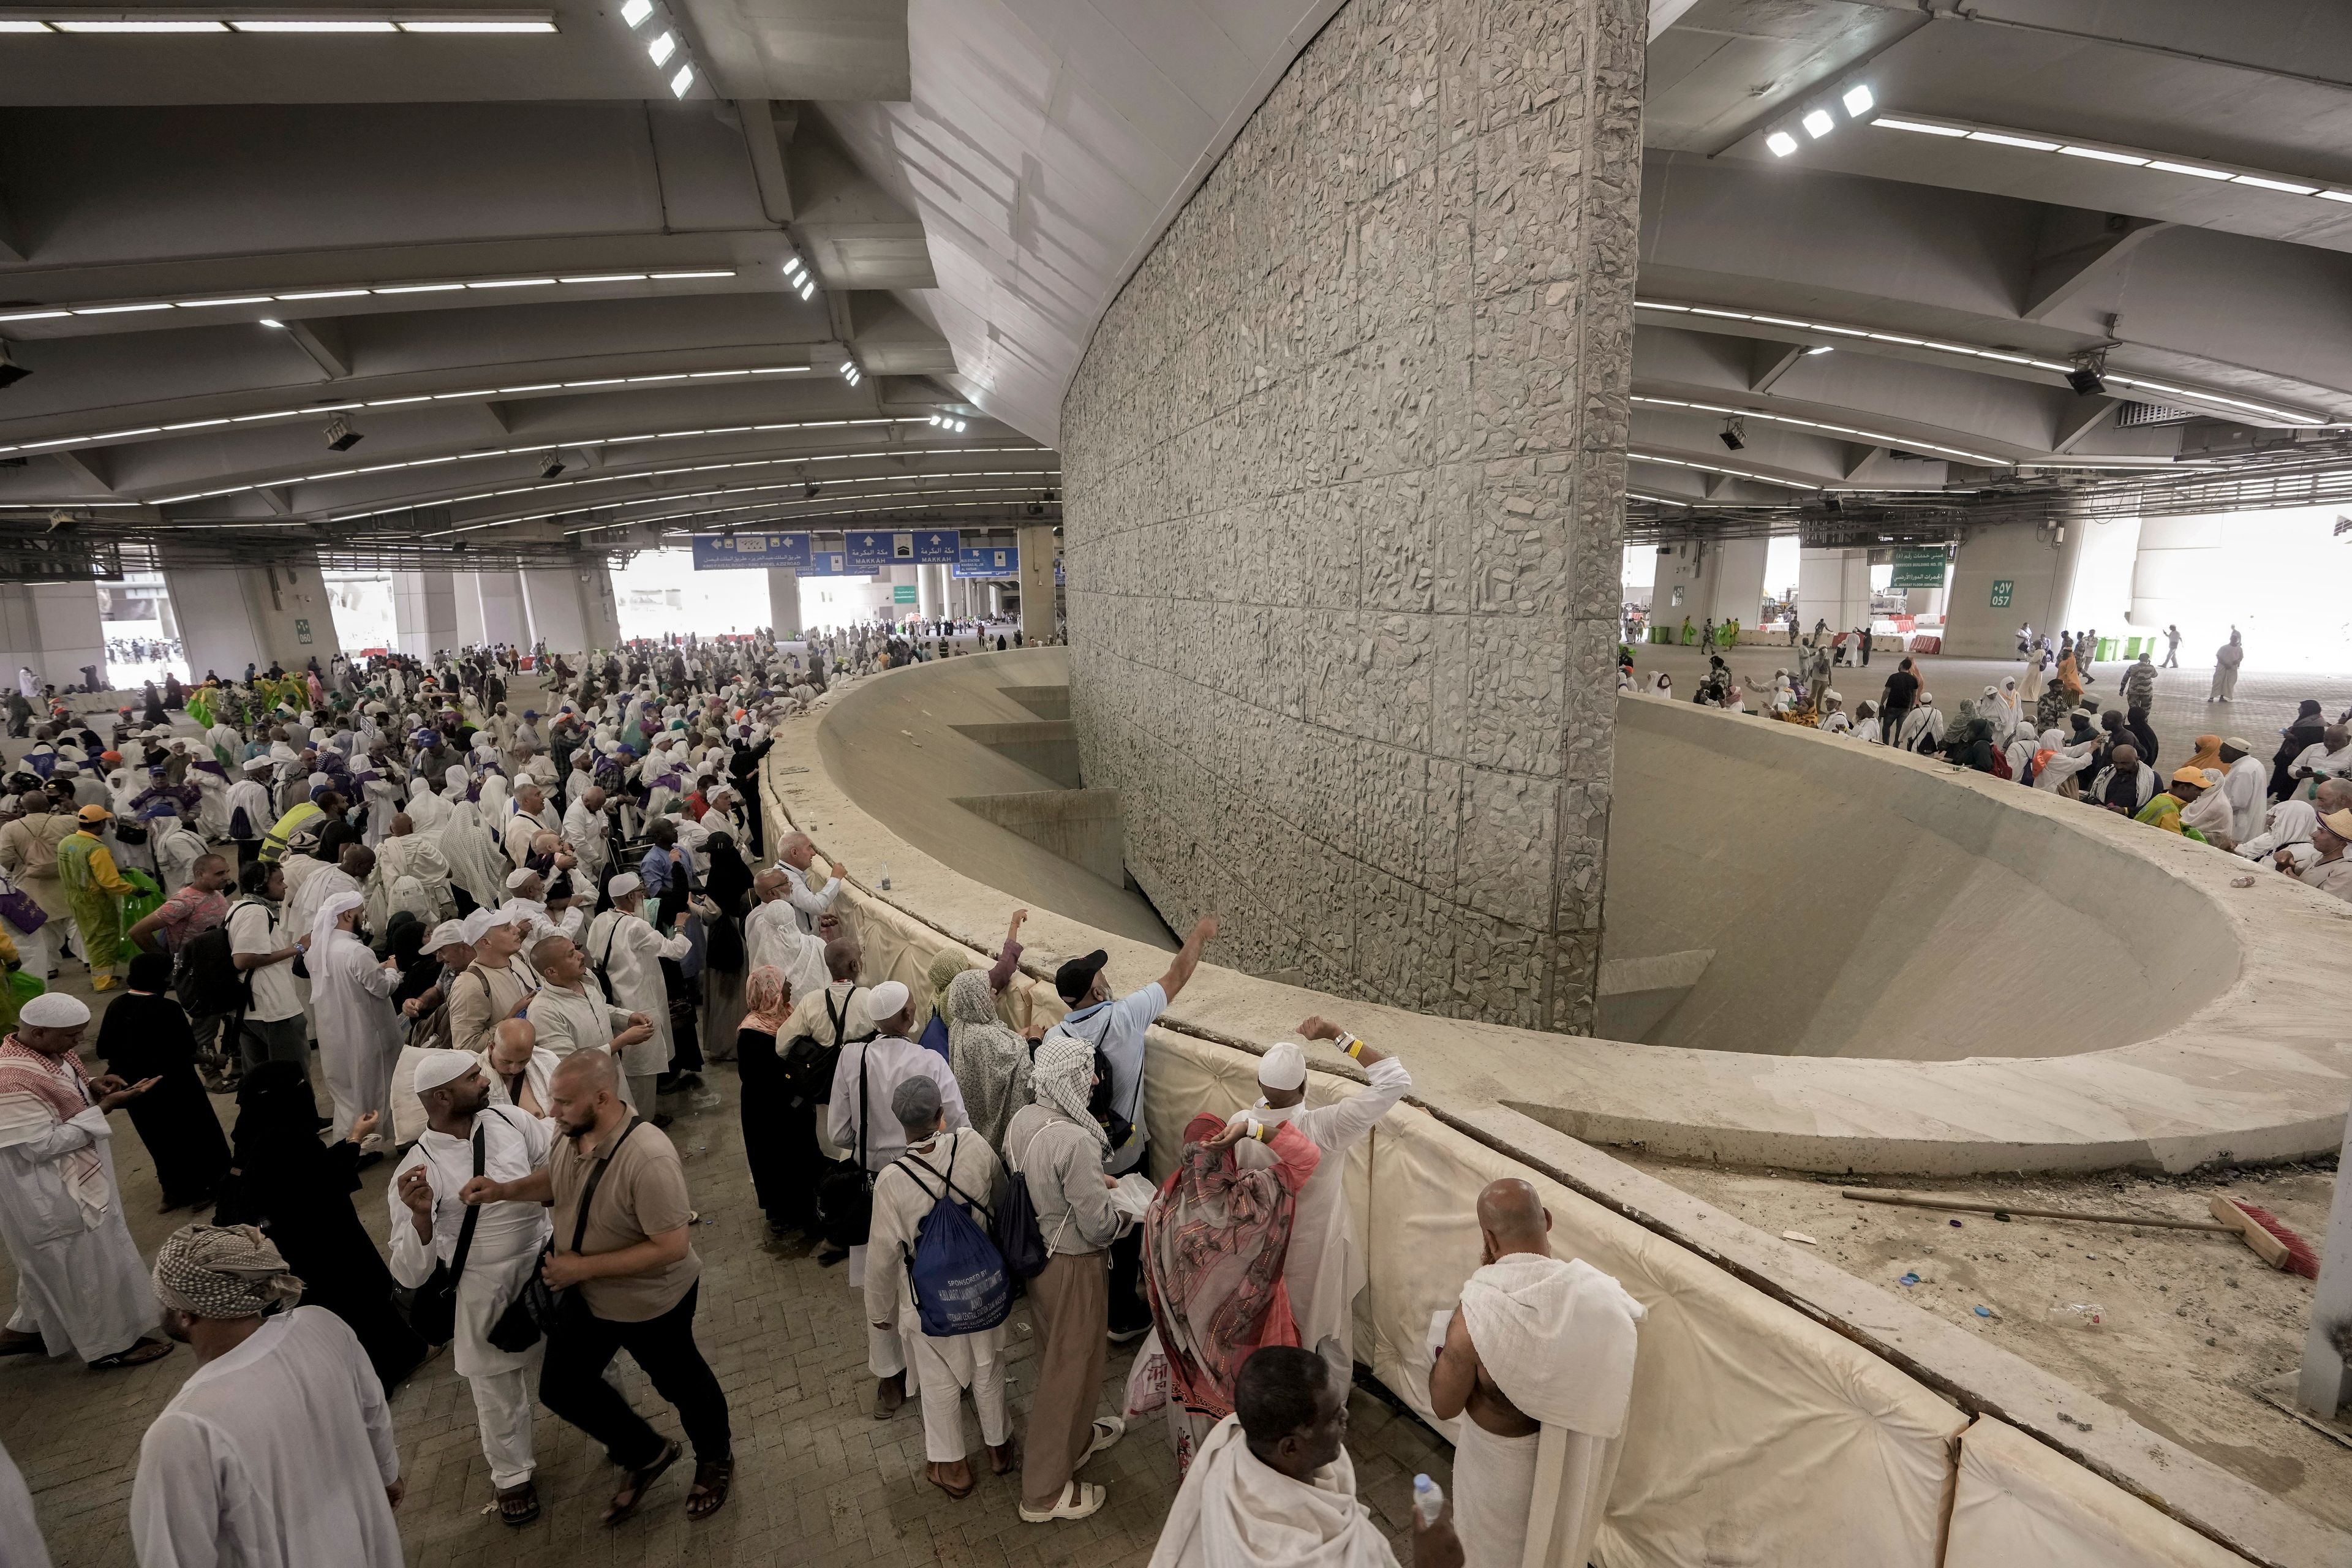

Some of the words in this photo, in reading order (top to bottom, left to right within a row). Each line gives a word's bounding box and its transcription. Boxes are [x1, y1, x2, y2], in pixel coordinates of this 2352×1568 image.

[921, 547, 941, 556] المكرمة
[1994, 582, 2011, 594] ٠٥٧
[1992, 596, 2010, 605] 057
[298, 621, 308, 631] ٠٦٠
[300, 633, 311, 643] 060
[948, 1273, 980, 1287] SPONSORED
[981, 1268, 987, 1277] BY
[970, 1297, 982, 1311] AND
[962, 1311, 978, 1321] CENTRAL
[976, 1305, 989, 1317] STATION
